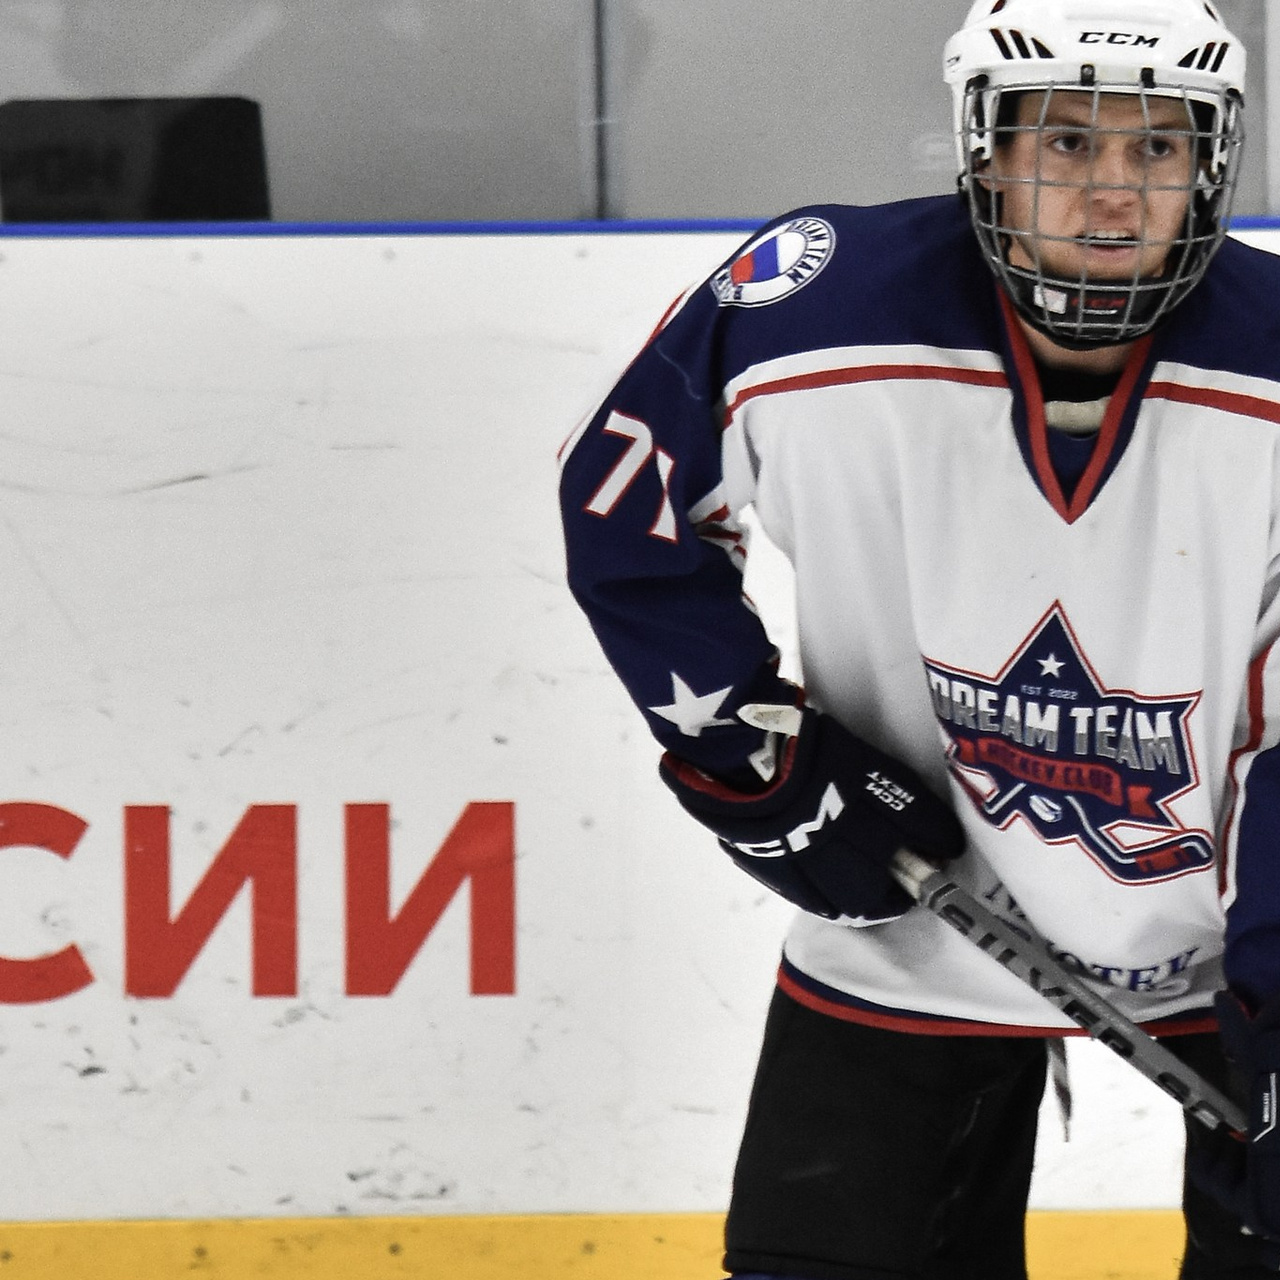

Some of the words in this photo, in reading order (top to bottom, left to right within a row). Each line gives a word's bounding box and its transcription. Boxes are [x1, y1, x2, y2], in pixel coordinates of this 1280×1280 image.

[1078, 31, 1160, 49] CCM
[787, 247, 826, 284] TEAM
[1048, 688, 1079, 701] 2022
[929, 671, 1061, 754] DREAM
[1069, 705, 1182, 776] TEAM
[866, 782, 906, 812] CCM
